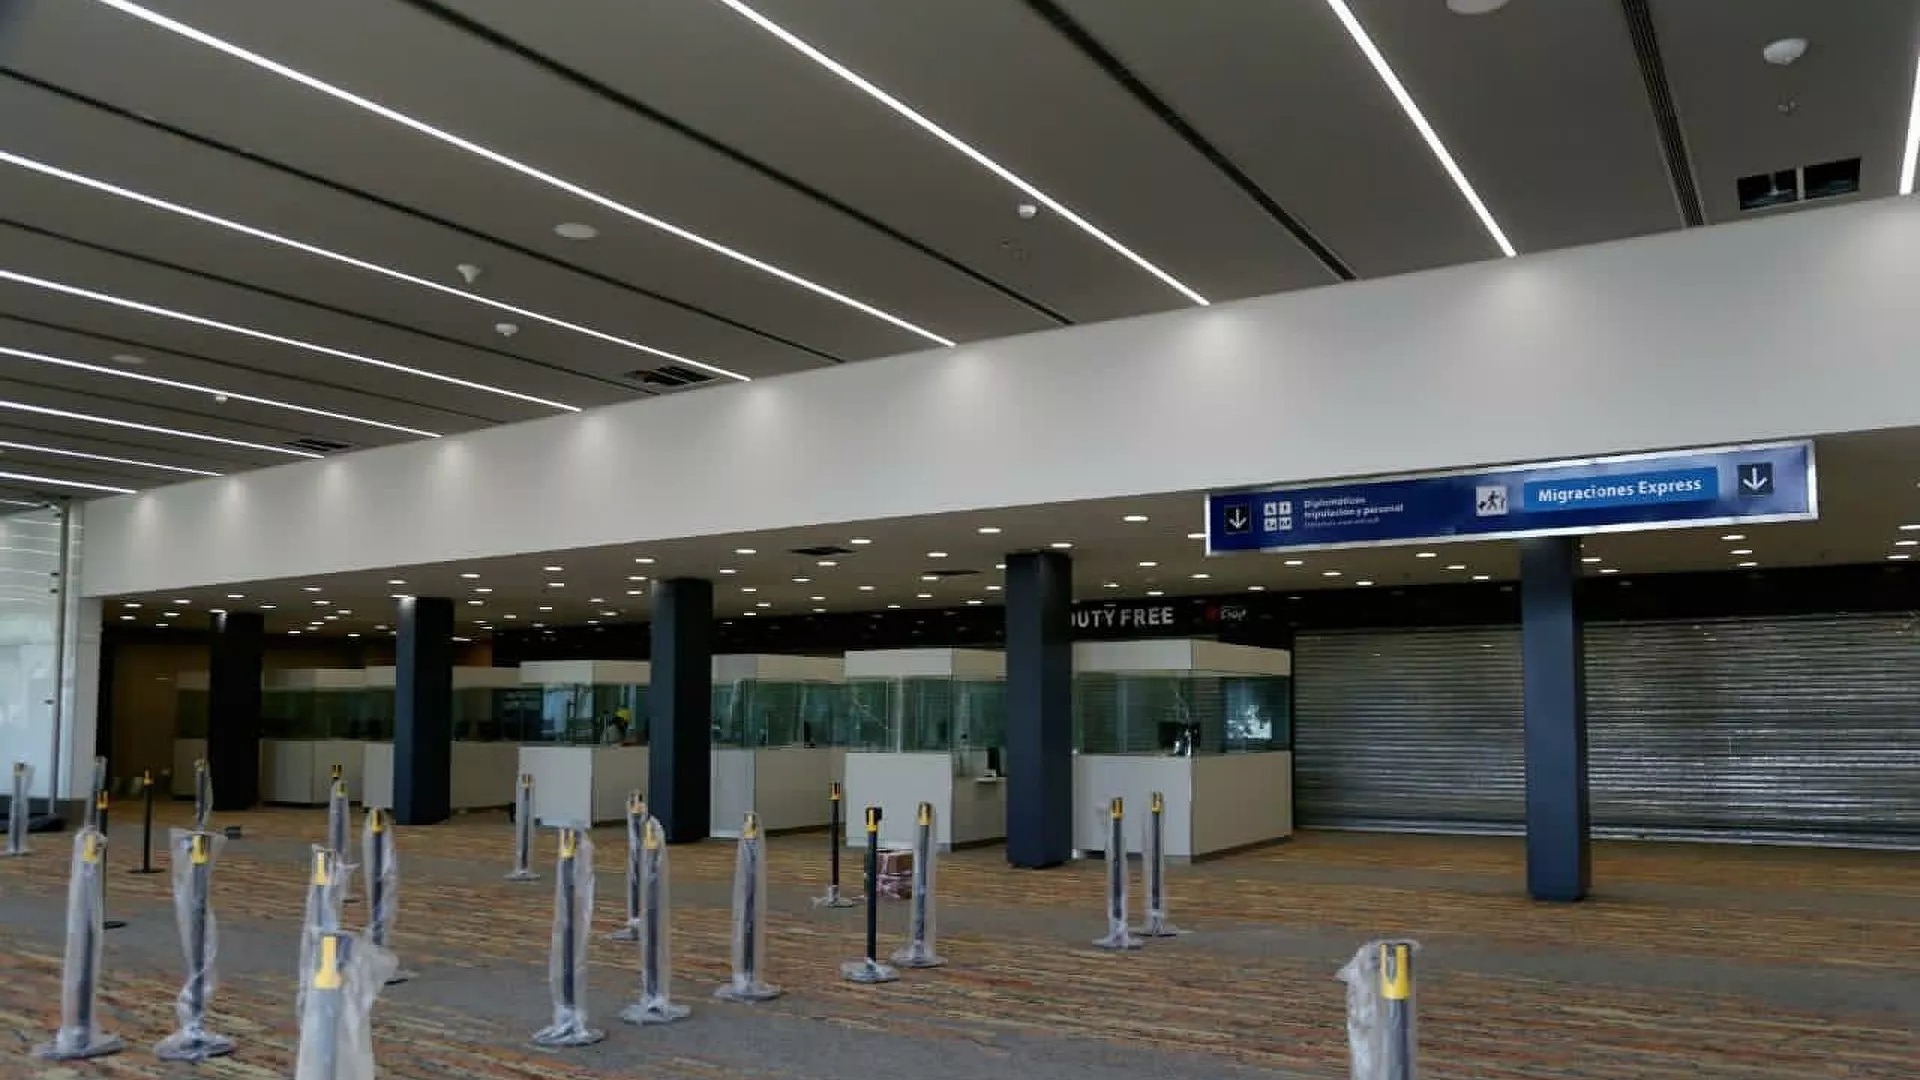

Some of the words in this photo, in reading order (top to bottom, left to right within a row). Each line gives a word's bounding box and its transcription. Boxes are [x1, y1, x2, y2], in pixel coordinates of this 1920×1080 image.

[1538, 484, 1634, 504] Migraciones
[1638, 478, 1702, 496] Express
[1120, 606, 1175, 628] FREE
